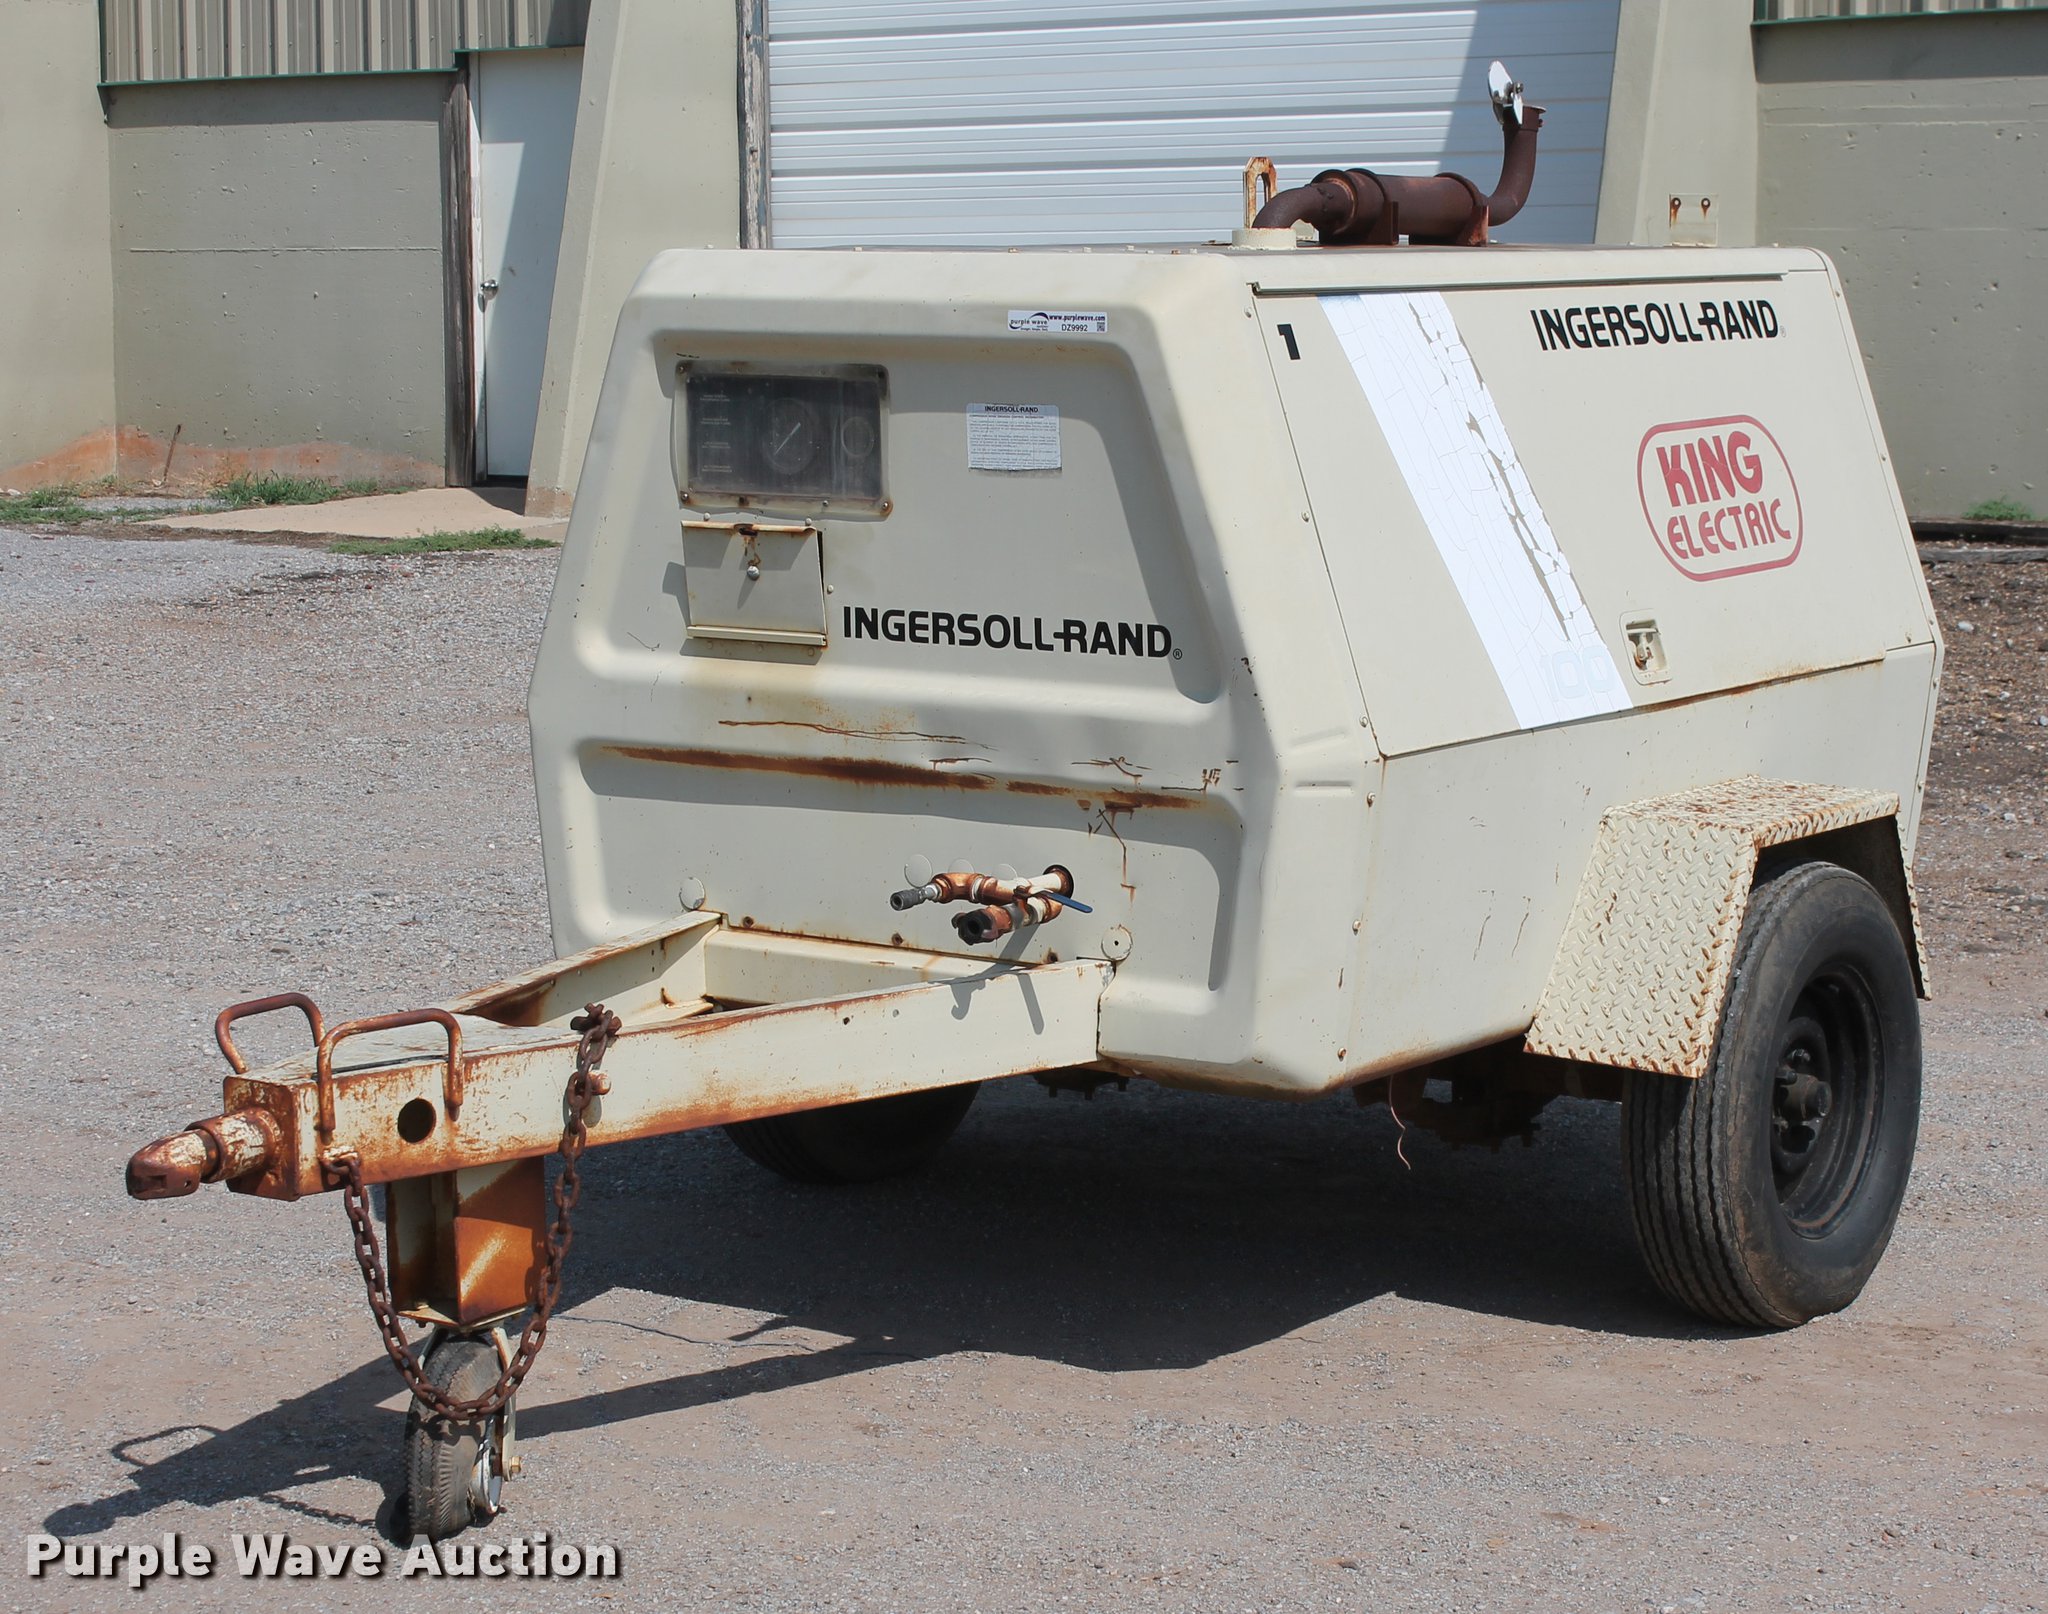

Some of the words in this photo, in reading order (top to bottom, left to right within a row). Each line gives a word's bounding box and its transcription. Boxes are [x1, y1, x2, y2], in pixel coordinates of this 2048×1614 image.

[1010, 318, 1030, 326] purple
[1048, 314, 1106, 322] www.purplewave.com
[1061, 323, 1088, 332] DZ9992
[1529, 299, 1778, 351] INGERSOLL-RAND
[1277, 323, 1301, 361] 1
[984, 405, 1039, 413] INGERSOLL-RAND
[1656, 430, 1763, 507] KING
[1666, 498, 1792, 559] ELECTRIC
[843, 605, 1173, 658] INGERSOLL-RAND
